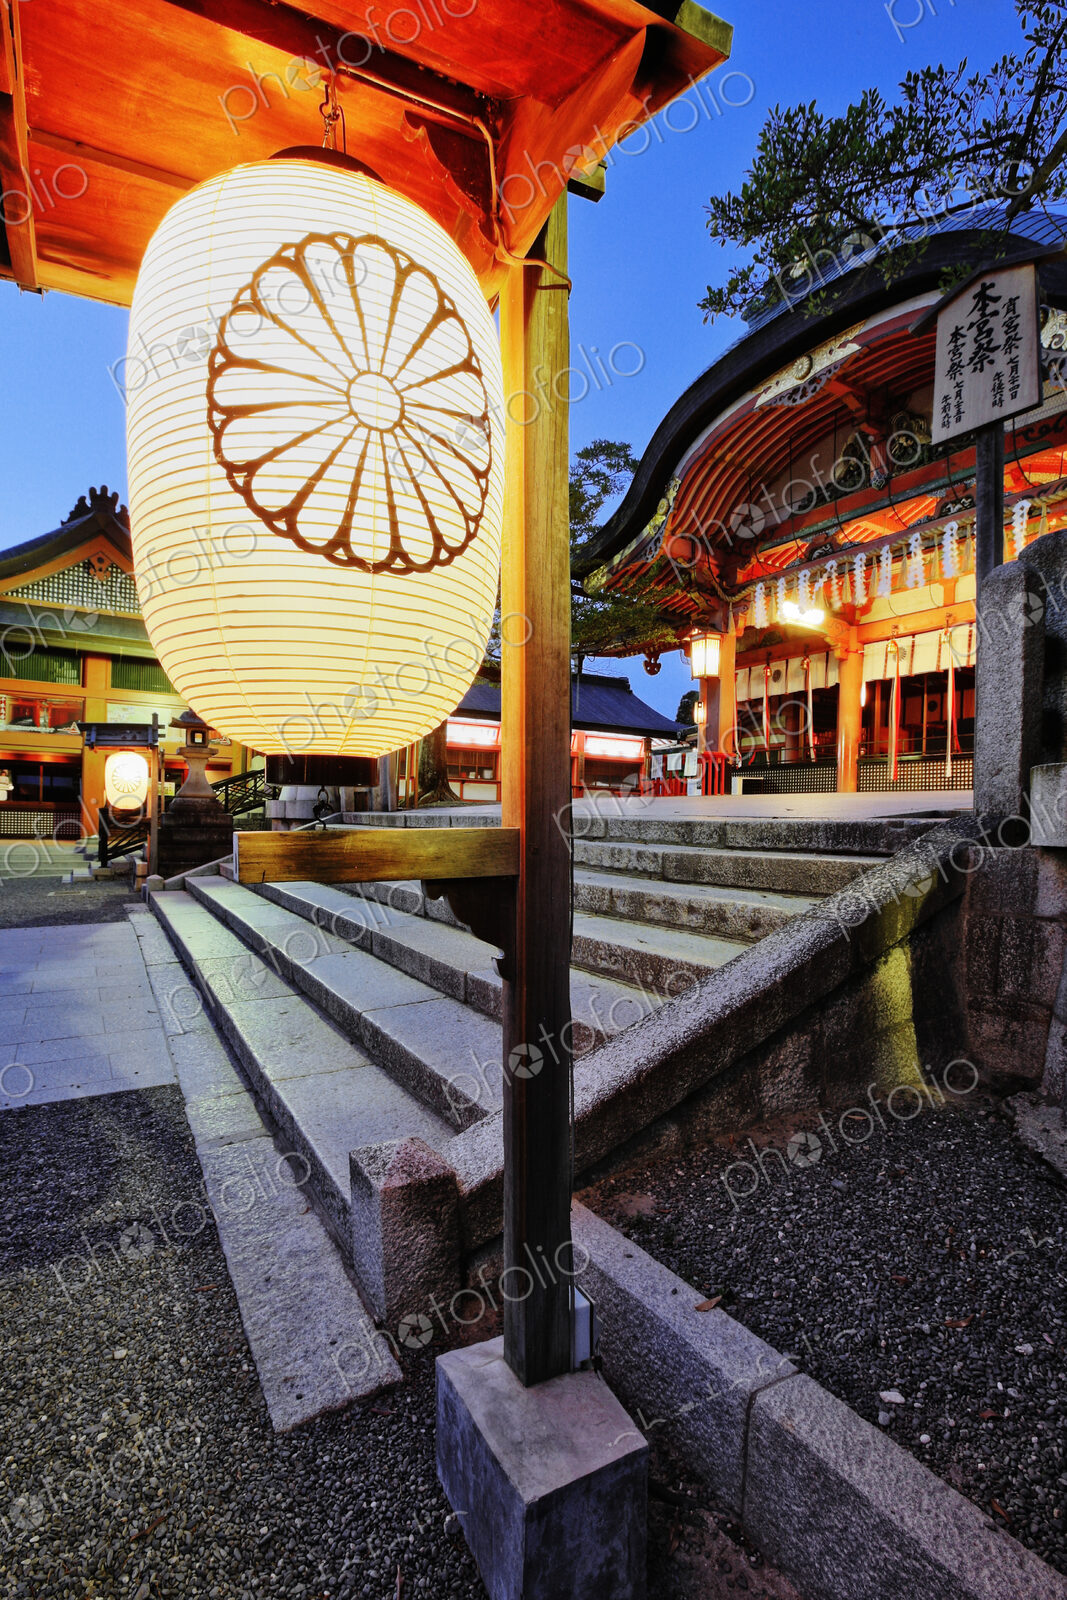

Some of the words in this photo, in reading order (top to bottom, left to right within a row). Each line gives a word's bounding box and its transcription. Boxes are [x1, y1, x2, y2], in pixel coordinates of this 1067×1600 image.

[945, 325, 967, 381] 本宮祭
[966, 282, 1002, 374] 本宮祭
